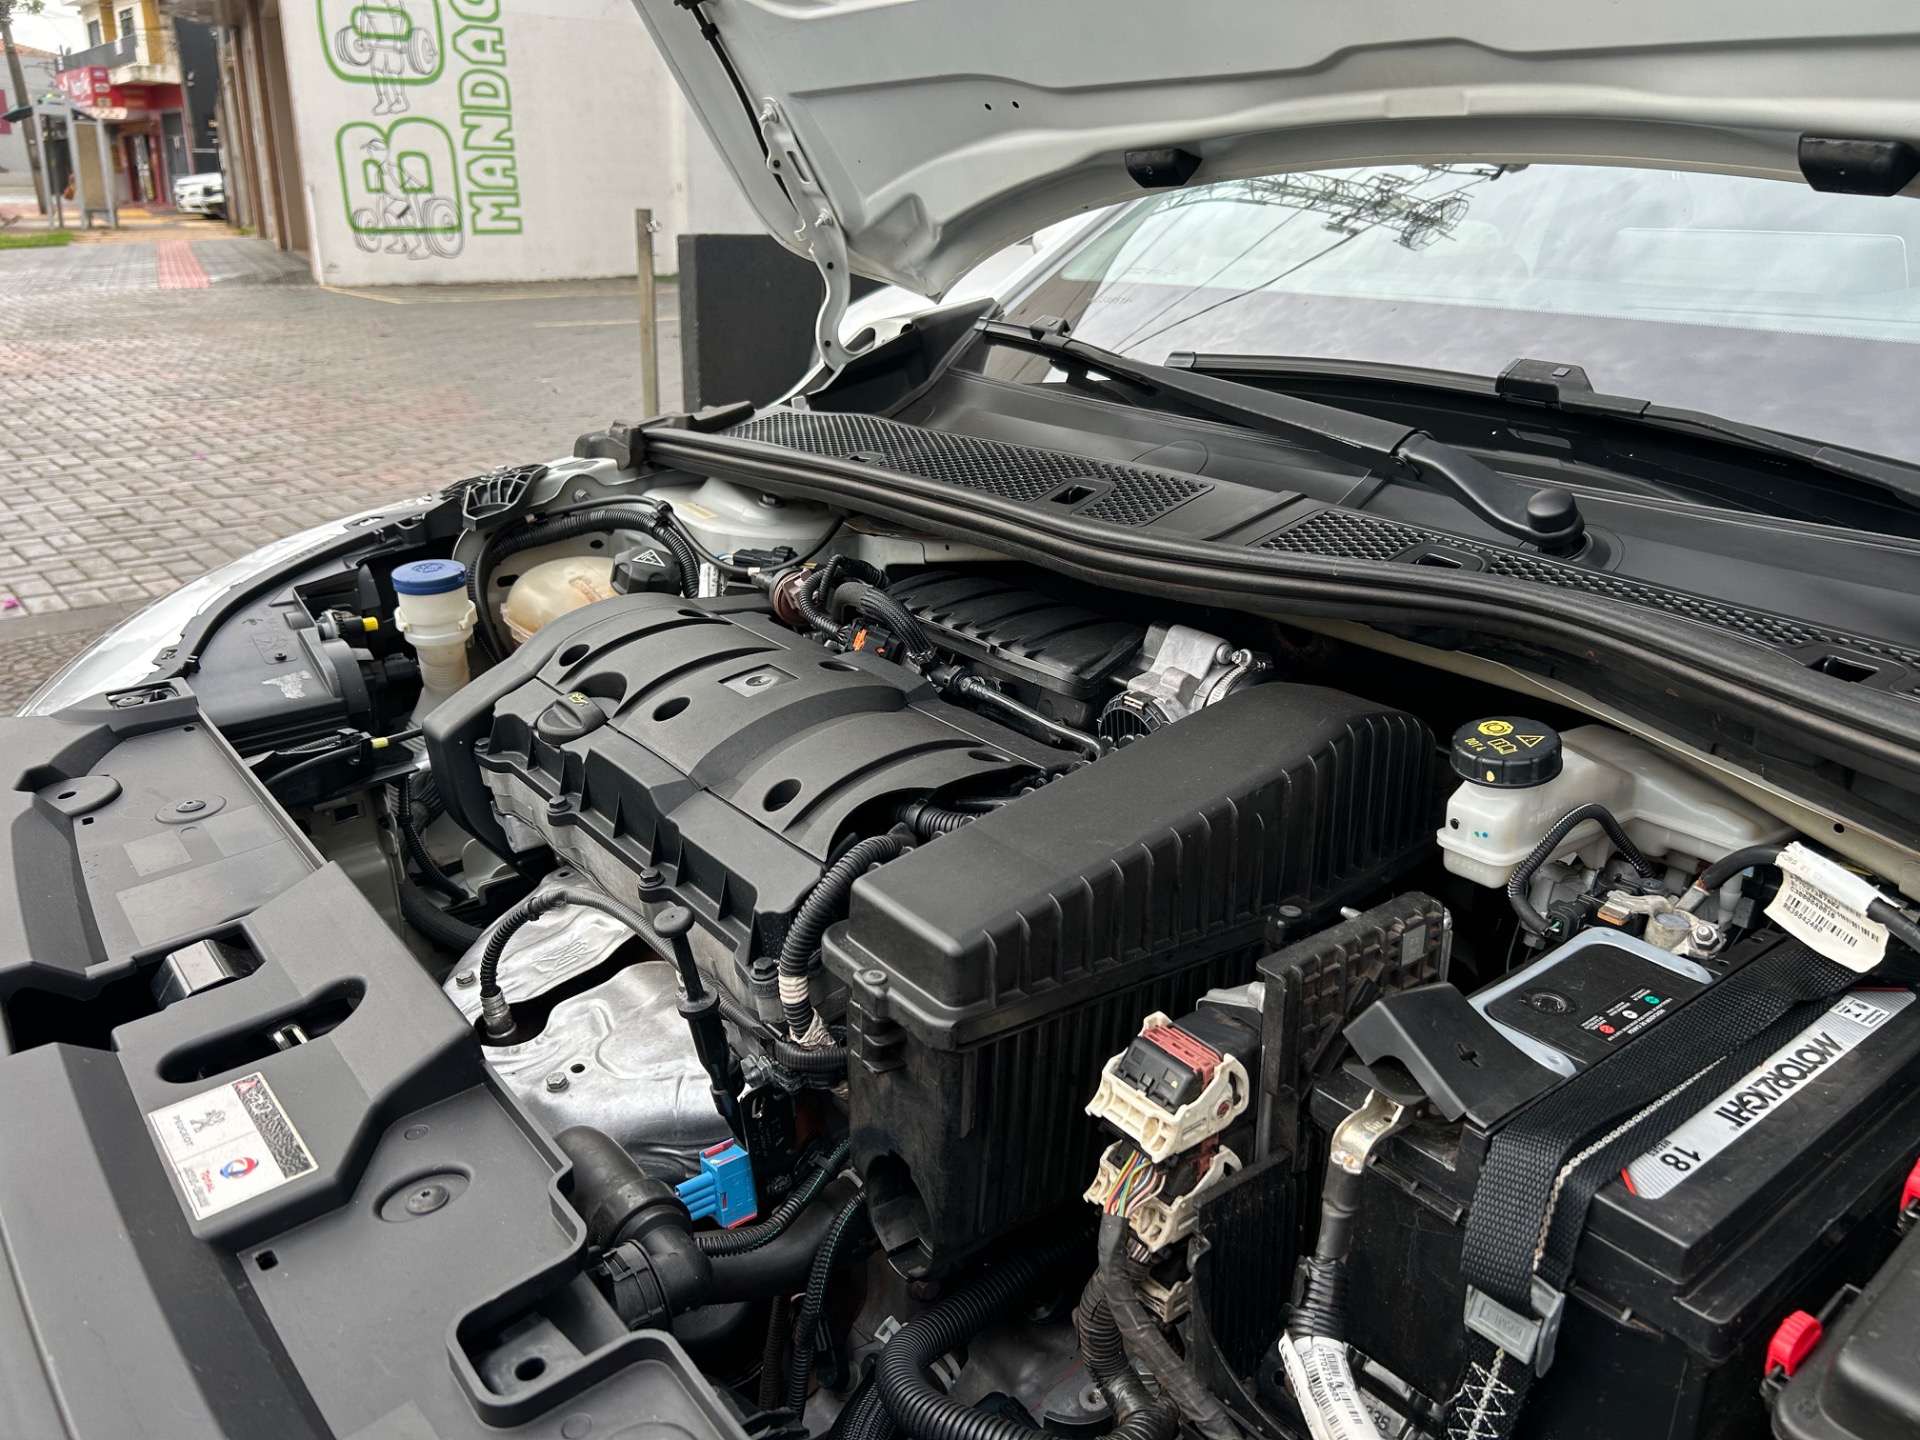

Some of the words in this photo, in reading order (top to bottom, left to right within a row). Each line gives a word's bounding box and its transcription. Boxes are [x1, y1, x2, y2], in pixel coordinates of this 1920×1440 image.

[1714, 1031, 1843, 1128] MOTORLIGHT
[172, 1115, 194, 1147] PEUGEOT
[1660, 1146, 1702, 1172] 18
